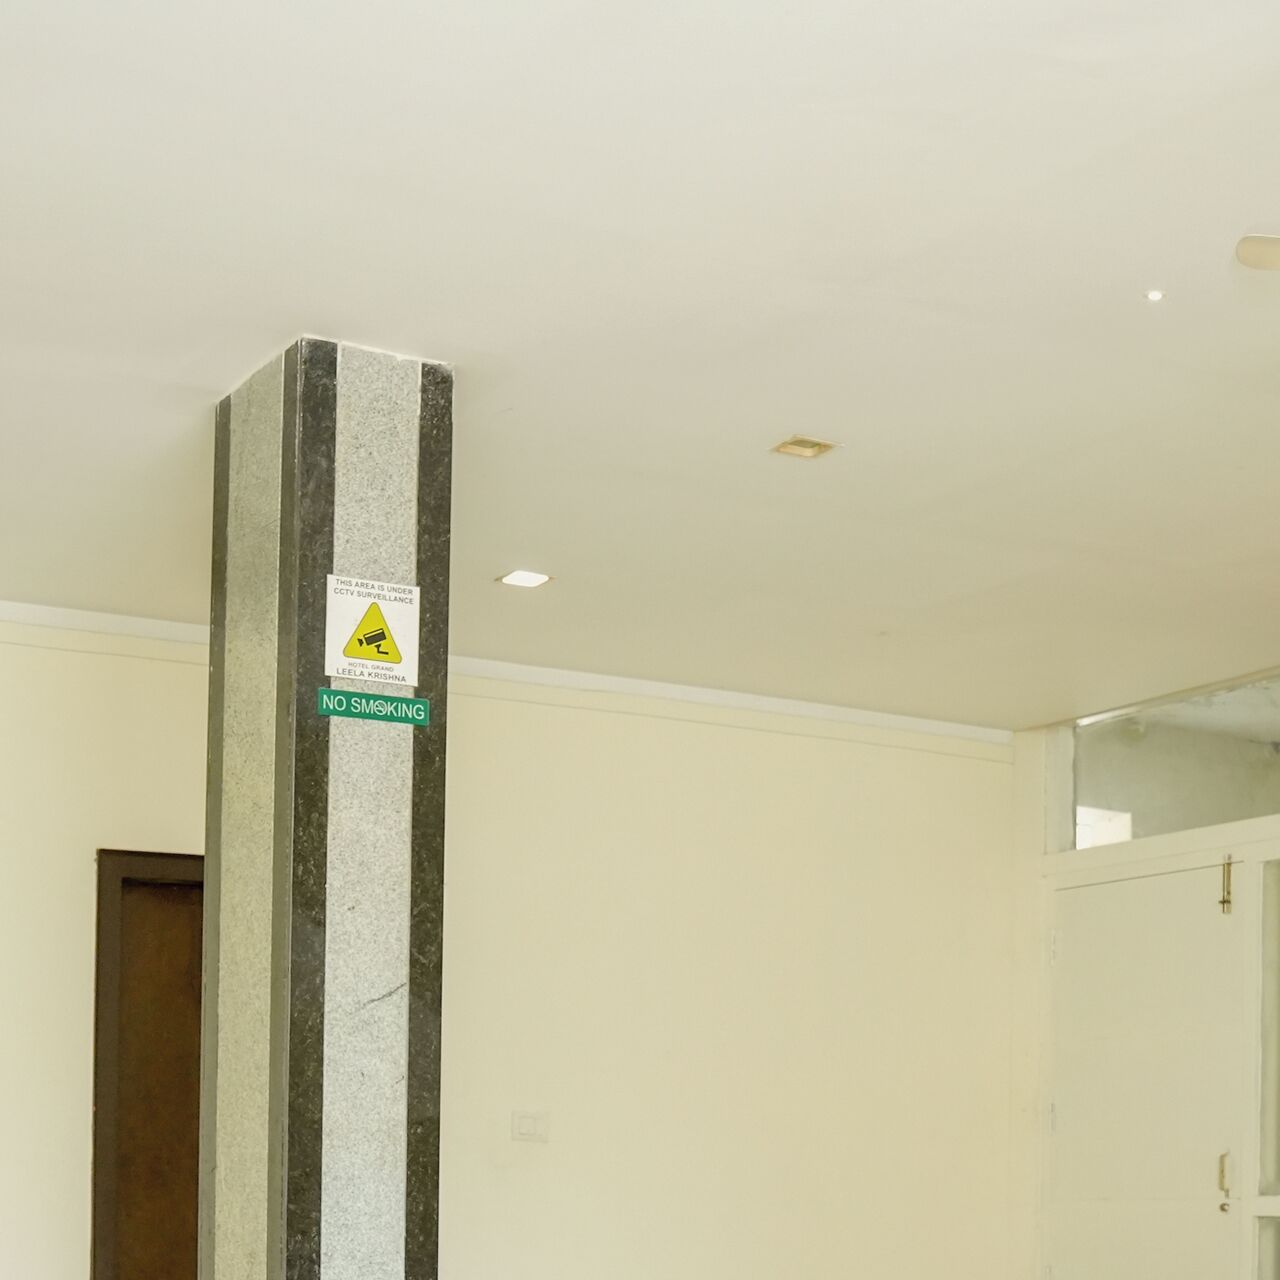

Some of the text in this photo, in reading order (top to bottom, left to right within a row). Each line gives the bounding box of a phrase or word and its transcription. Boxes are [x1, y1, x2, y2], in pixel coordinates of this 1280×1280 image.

[333, 587, 415, 605] CCTV SURVEILLANCE
[336, 578, 414, 596] THIS AREA IS UNDER
[336, 668, 407, 683] LEELA KRISHNA
[348, 662, 395, 672] HOTEL GRAND
[322, 694, 425, 720] NO SMOKING
